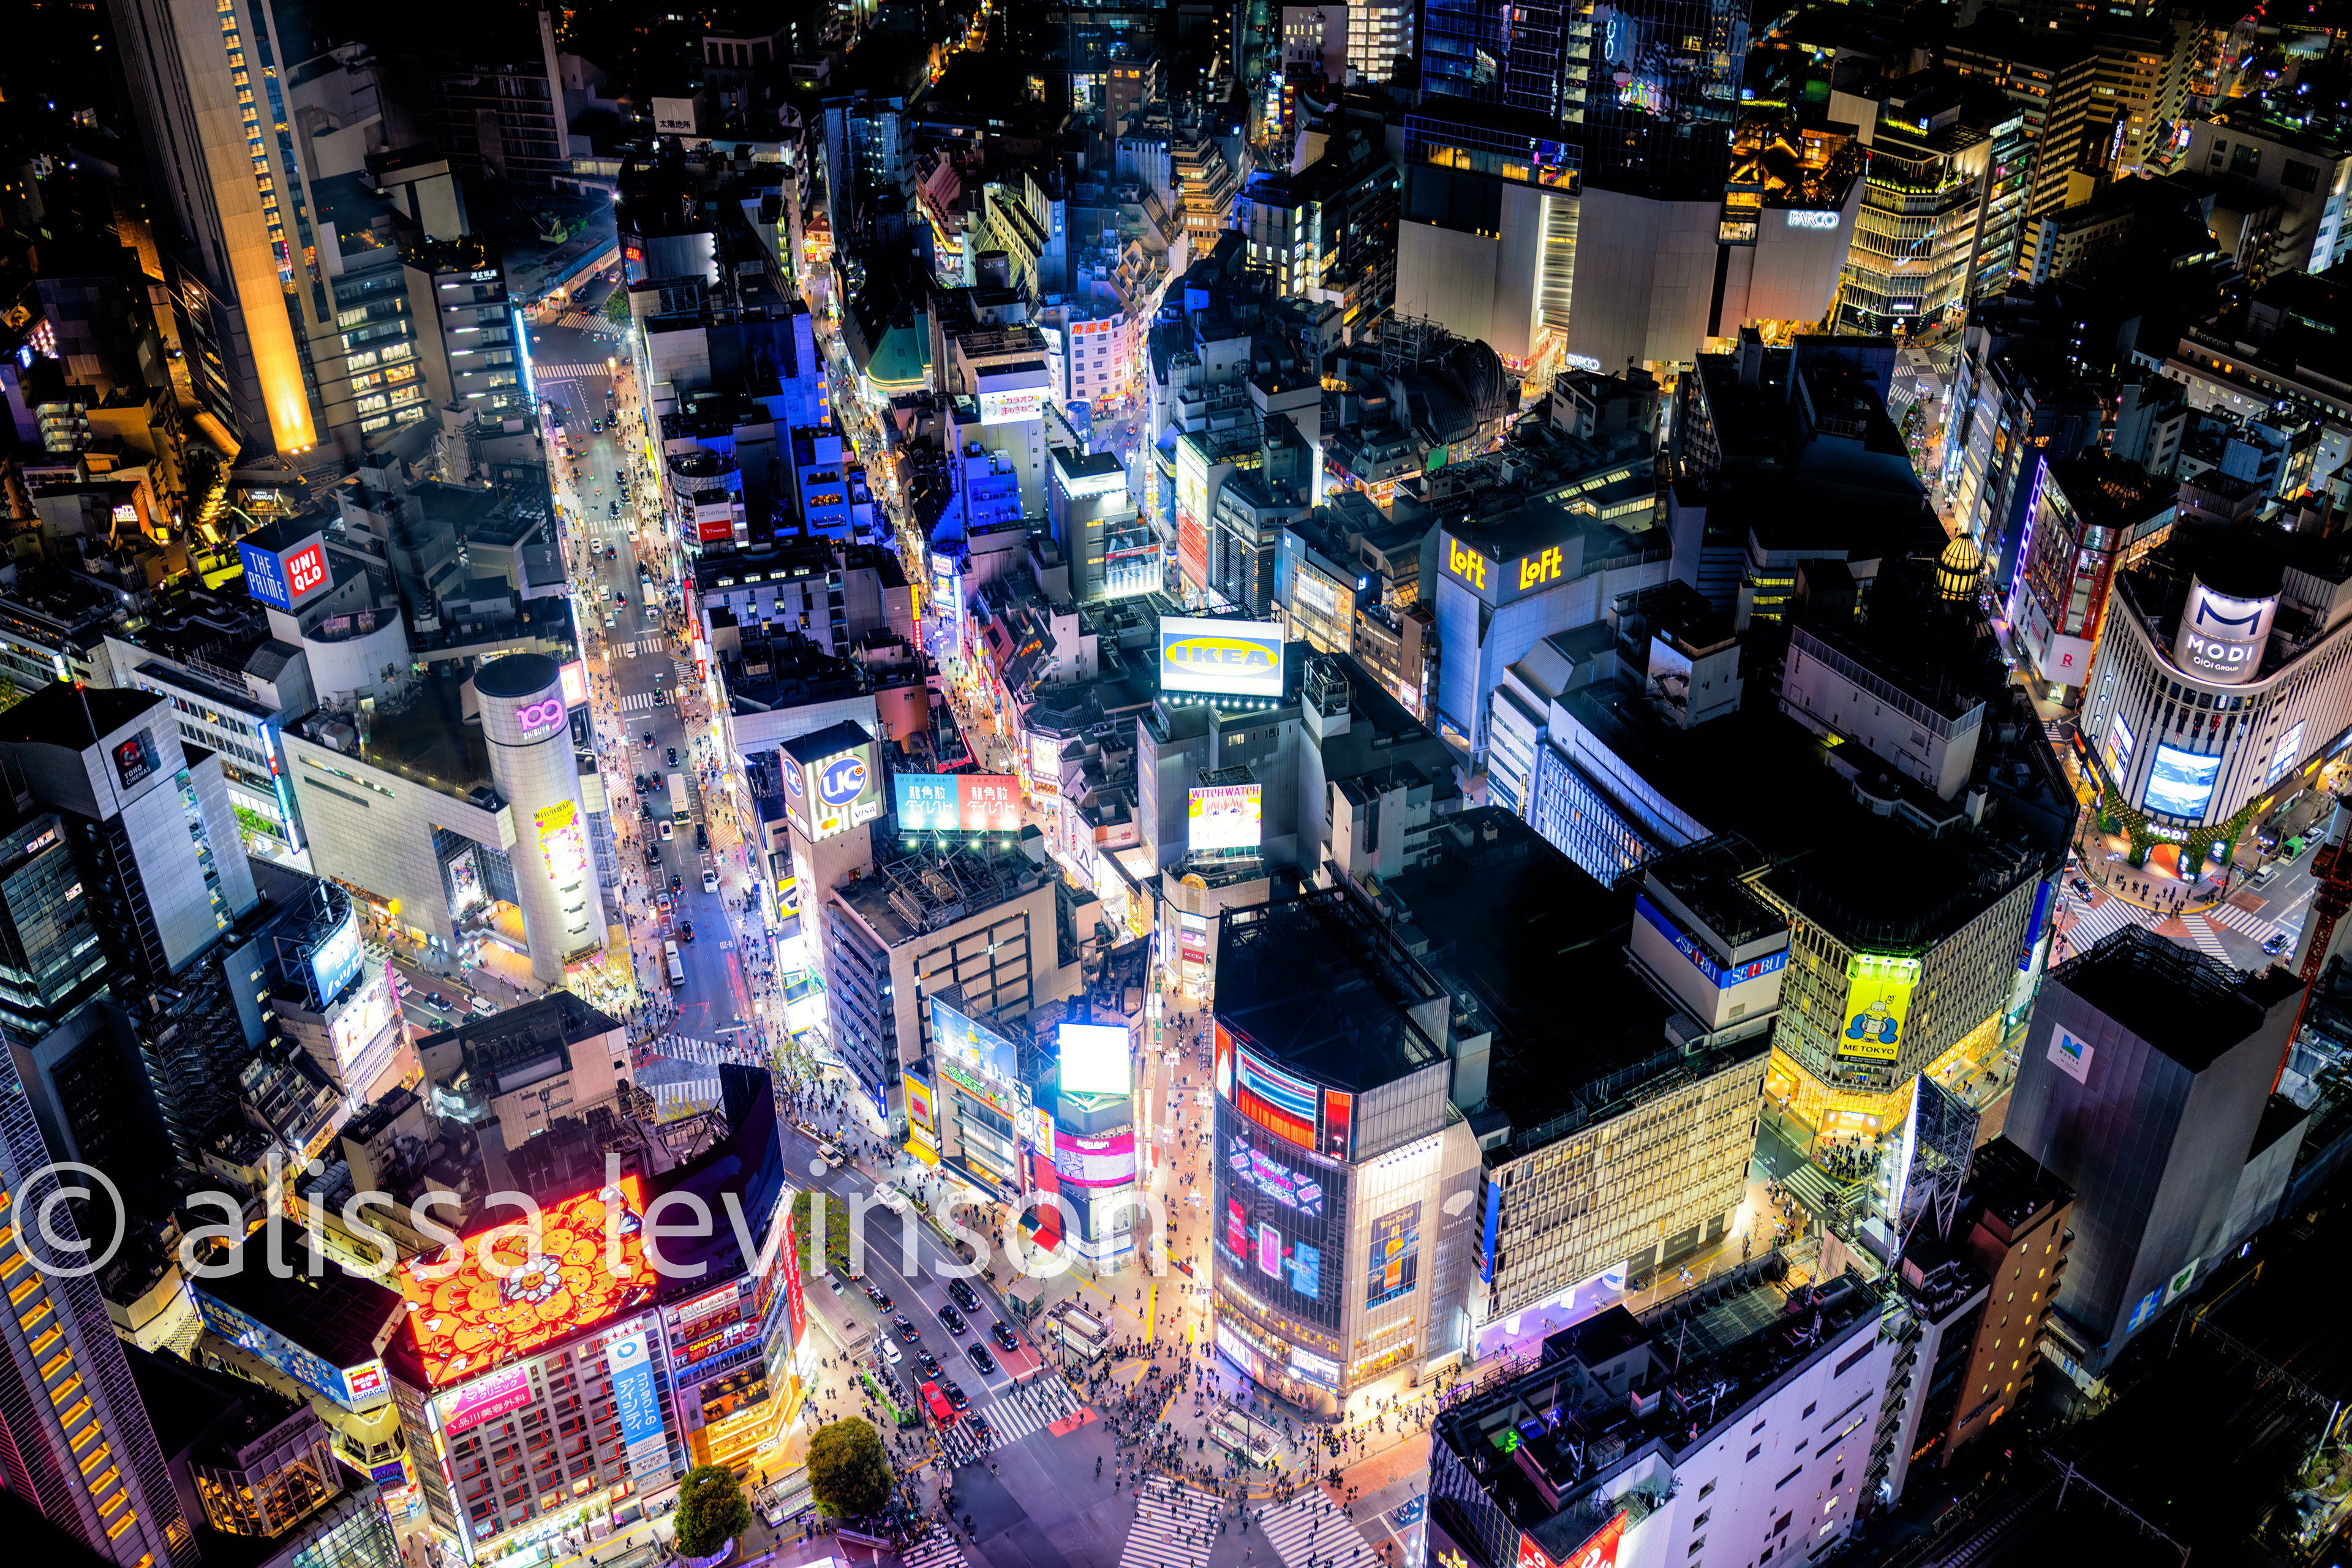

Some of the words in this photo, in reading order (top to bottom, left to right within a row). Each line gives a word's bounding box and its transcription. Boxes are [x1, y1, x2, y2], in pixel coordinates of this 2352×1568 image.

[660, 119, 690, 129] 太陽地所
[1789, 211, 1838, 228] PARCO
[1566, 353, 1599, 371] PARCO
[1005, 396, 1034, 404] カラオケ
[1001, 405, 1034, 416] まねきねこ
[1115, 548, 1149, 557] SKECHERS
[249, 551, 274, 578] THE
[290, 550, 316, 575] UNI
[248, 571, 286, 601] PRIME
[294, 565, 322, 592] QLO
[1175, 646, 1270, 667] IKEA
[2188, 635, 2253, 662] MODI
[2215, 662, 2239, 673] GROUP
[516, 699, 563, 731] 109
[523, 724, 551, 741] SHIBUYA
[124, 764, 141, 779] TOHO
[126, 766, 151, 785] CINEMAS
[909, 785, 946, 799] 龍角散
[971, 786, 1008, 800] 龍角散
[854, 805, 876, 819] VISA
[2147, 823, 2188, 843] MODI
[1184, 952, 1203, 960] ACCEA
[1731, 954, 1781, 984] SEIBU
[933, 1001, 943, 1012] Blue
[942, 1007, 953, 1019] Label
[1844, 1043, 1859, 1053] ME
[1860, 1046, 1895, 1056] TOKYO
[962, 1076, 984, 1097] 西村
[1076, 1139, 1107, 1150] Rakuten
[1038, 1187, 1058, 1207] クスリ
[1379, 1218, 1396, 1231] Blue
[1396, 1209, 1414, 1223] Label
[1442, 1215, 1471, 1231] TSUTAYA
[666, 1310, 678, 1321] 9F
[721, 1322, 752, 1340] ガスト
[1225, 1316, 1277, 1359] STARBUCKS
[706, 1334, 740, 1356] ガスト
[1354, 1336, 1413, 1365] STARBUCKS
[614, 1352, 644, 1370] eyecity
[676, 1354, 688, 1366] 7F
[478, 1376, 518, 1401] クリニック
[1303, 1376, 1326, 1390] TSUTAYA
[352, 1385, 386, 1401] ESPACE
[636, 1371, 657, 1426] コンタクトの
[458, 1392, 527, 1428] 品川美容外科
[618, 1377, 641, 1431] アイシティ
[635, 1436, 656, 1447] CONTACT
[379, 1474, 400, 1483] CHANCE
[514, 1511, 579, 1547] サンドラッグ
